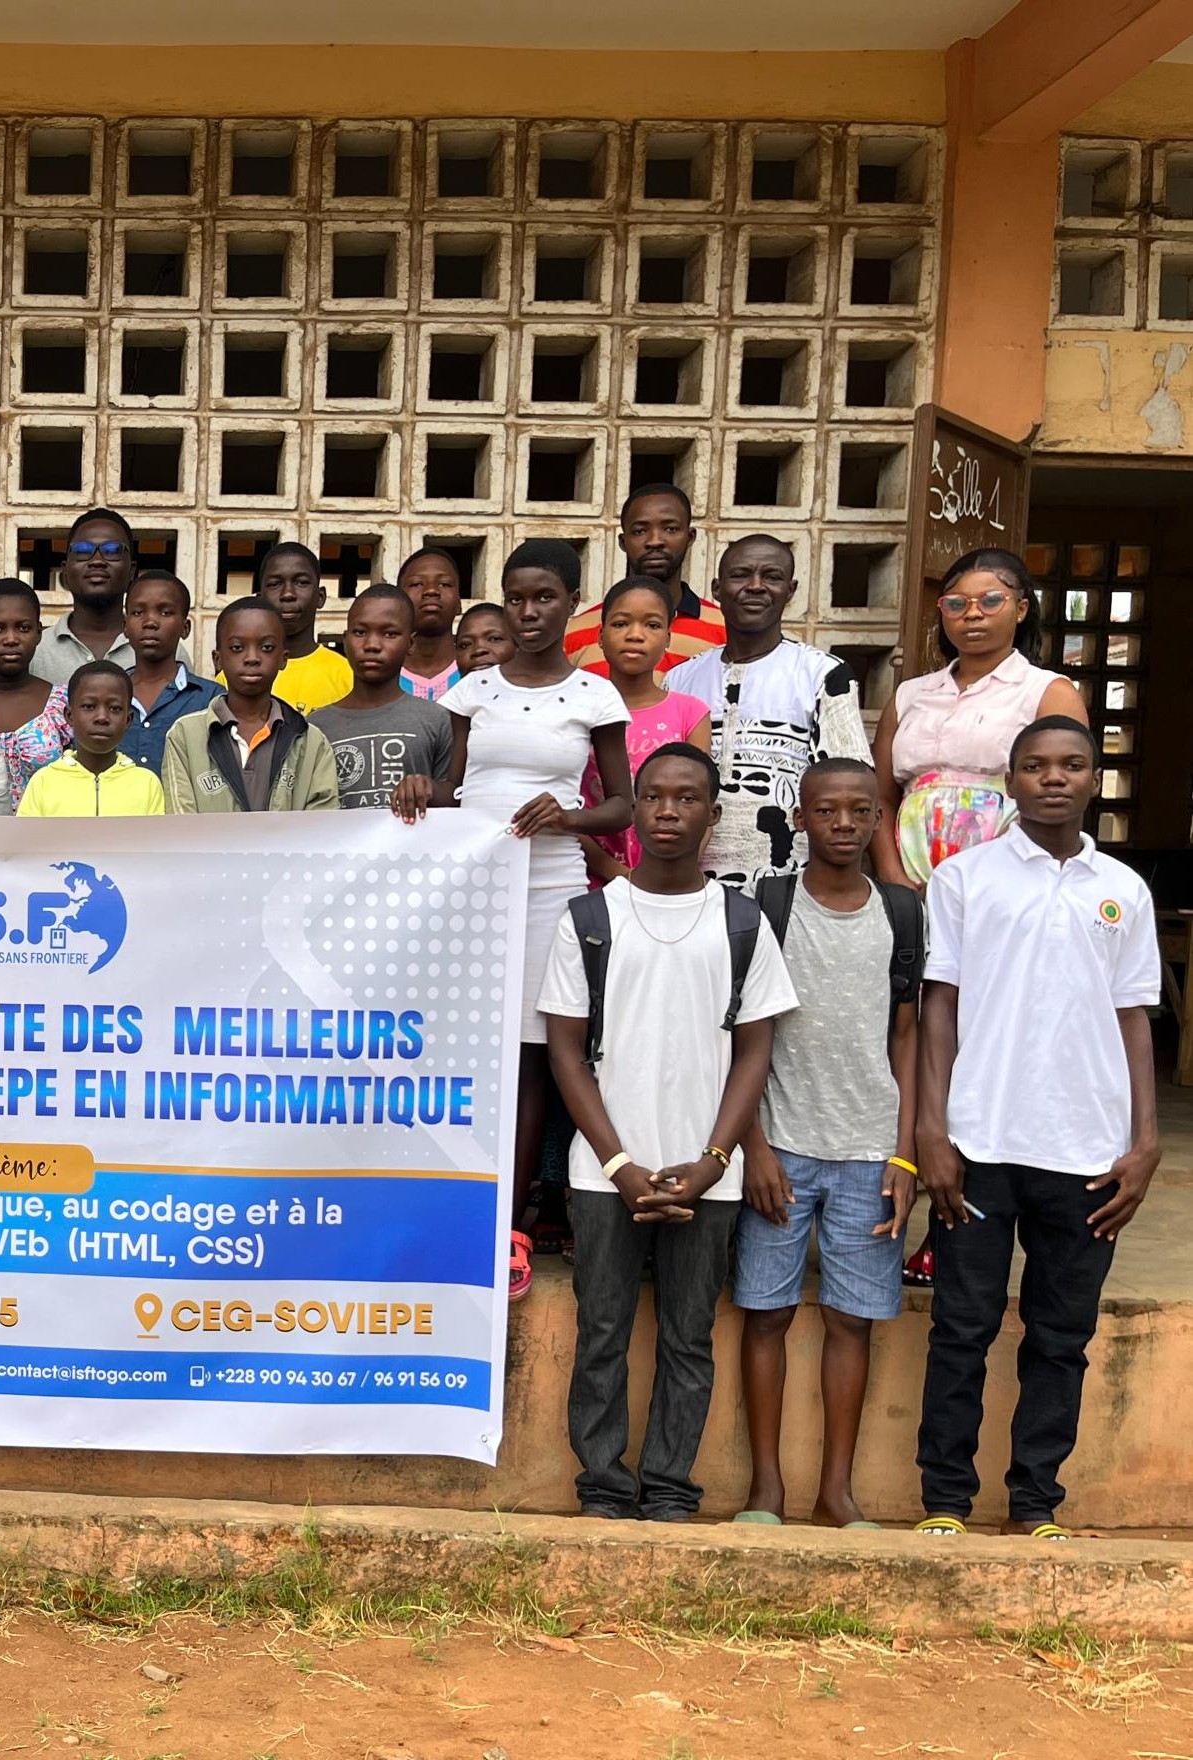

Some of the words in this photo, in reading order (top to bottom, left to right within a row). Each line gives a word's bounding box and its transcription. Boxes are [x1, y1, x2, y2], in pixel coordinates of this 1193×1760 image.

[0, 952, 27, 963] SANS
[31, 953, 88, 964] FRONTIERE
[62, 1004, 143, 1054] DES
[174, 1006, 425, 1060] MEILLEURS
[74, 1069, 127, 1119] EN
[144, 1071, 474, 1128] INFORMATIQUE
[64, 1198, 98, 1218] au
[110, 1195, 235, 1226] codage
[247, 1200, 278, 1224] et
[289, 1198, 305, 1224] à
[317, 1197, 341, 1224] la
[69, 1228, 175, 1267] (HTML,
[188, 1234, 263, 1267] CSS)
[171, 1300, 433, 1334] CEG-SOVIEPE
[215, 1368, 256, 1384] +228
[259, 1369, 282, 1385] 90
[285, 1370, 308, 1386] 94
[311, 1371, 334, 1386] 30
[337, 1371, 357, 1387] 67
[374, 1371, 394, 1386] 96
[397, 1371, 415, 1386] 91
[419, 1372, 441, 1387] 56
[444, 1373, 468, 1389] 09
